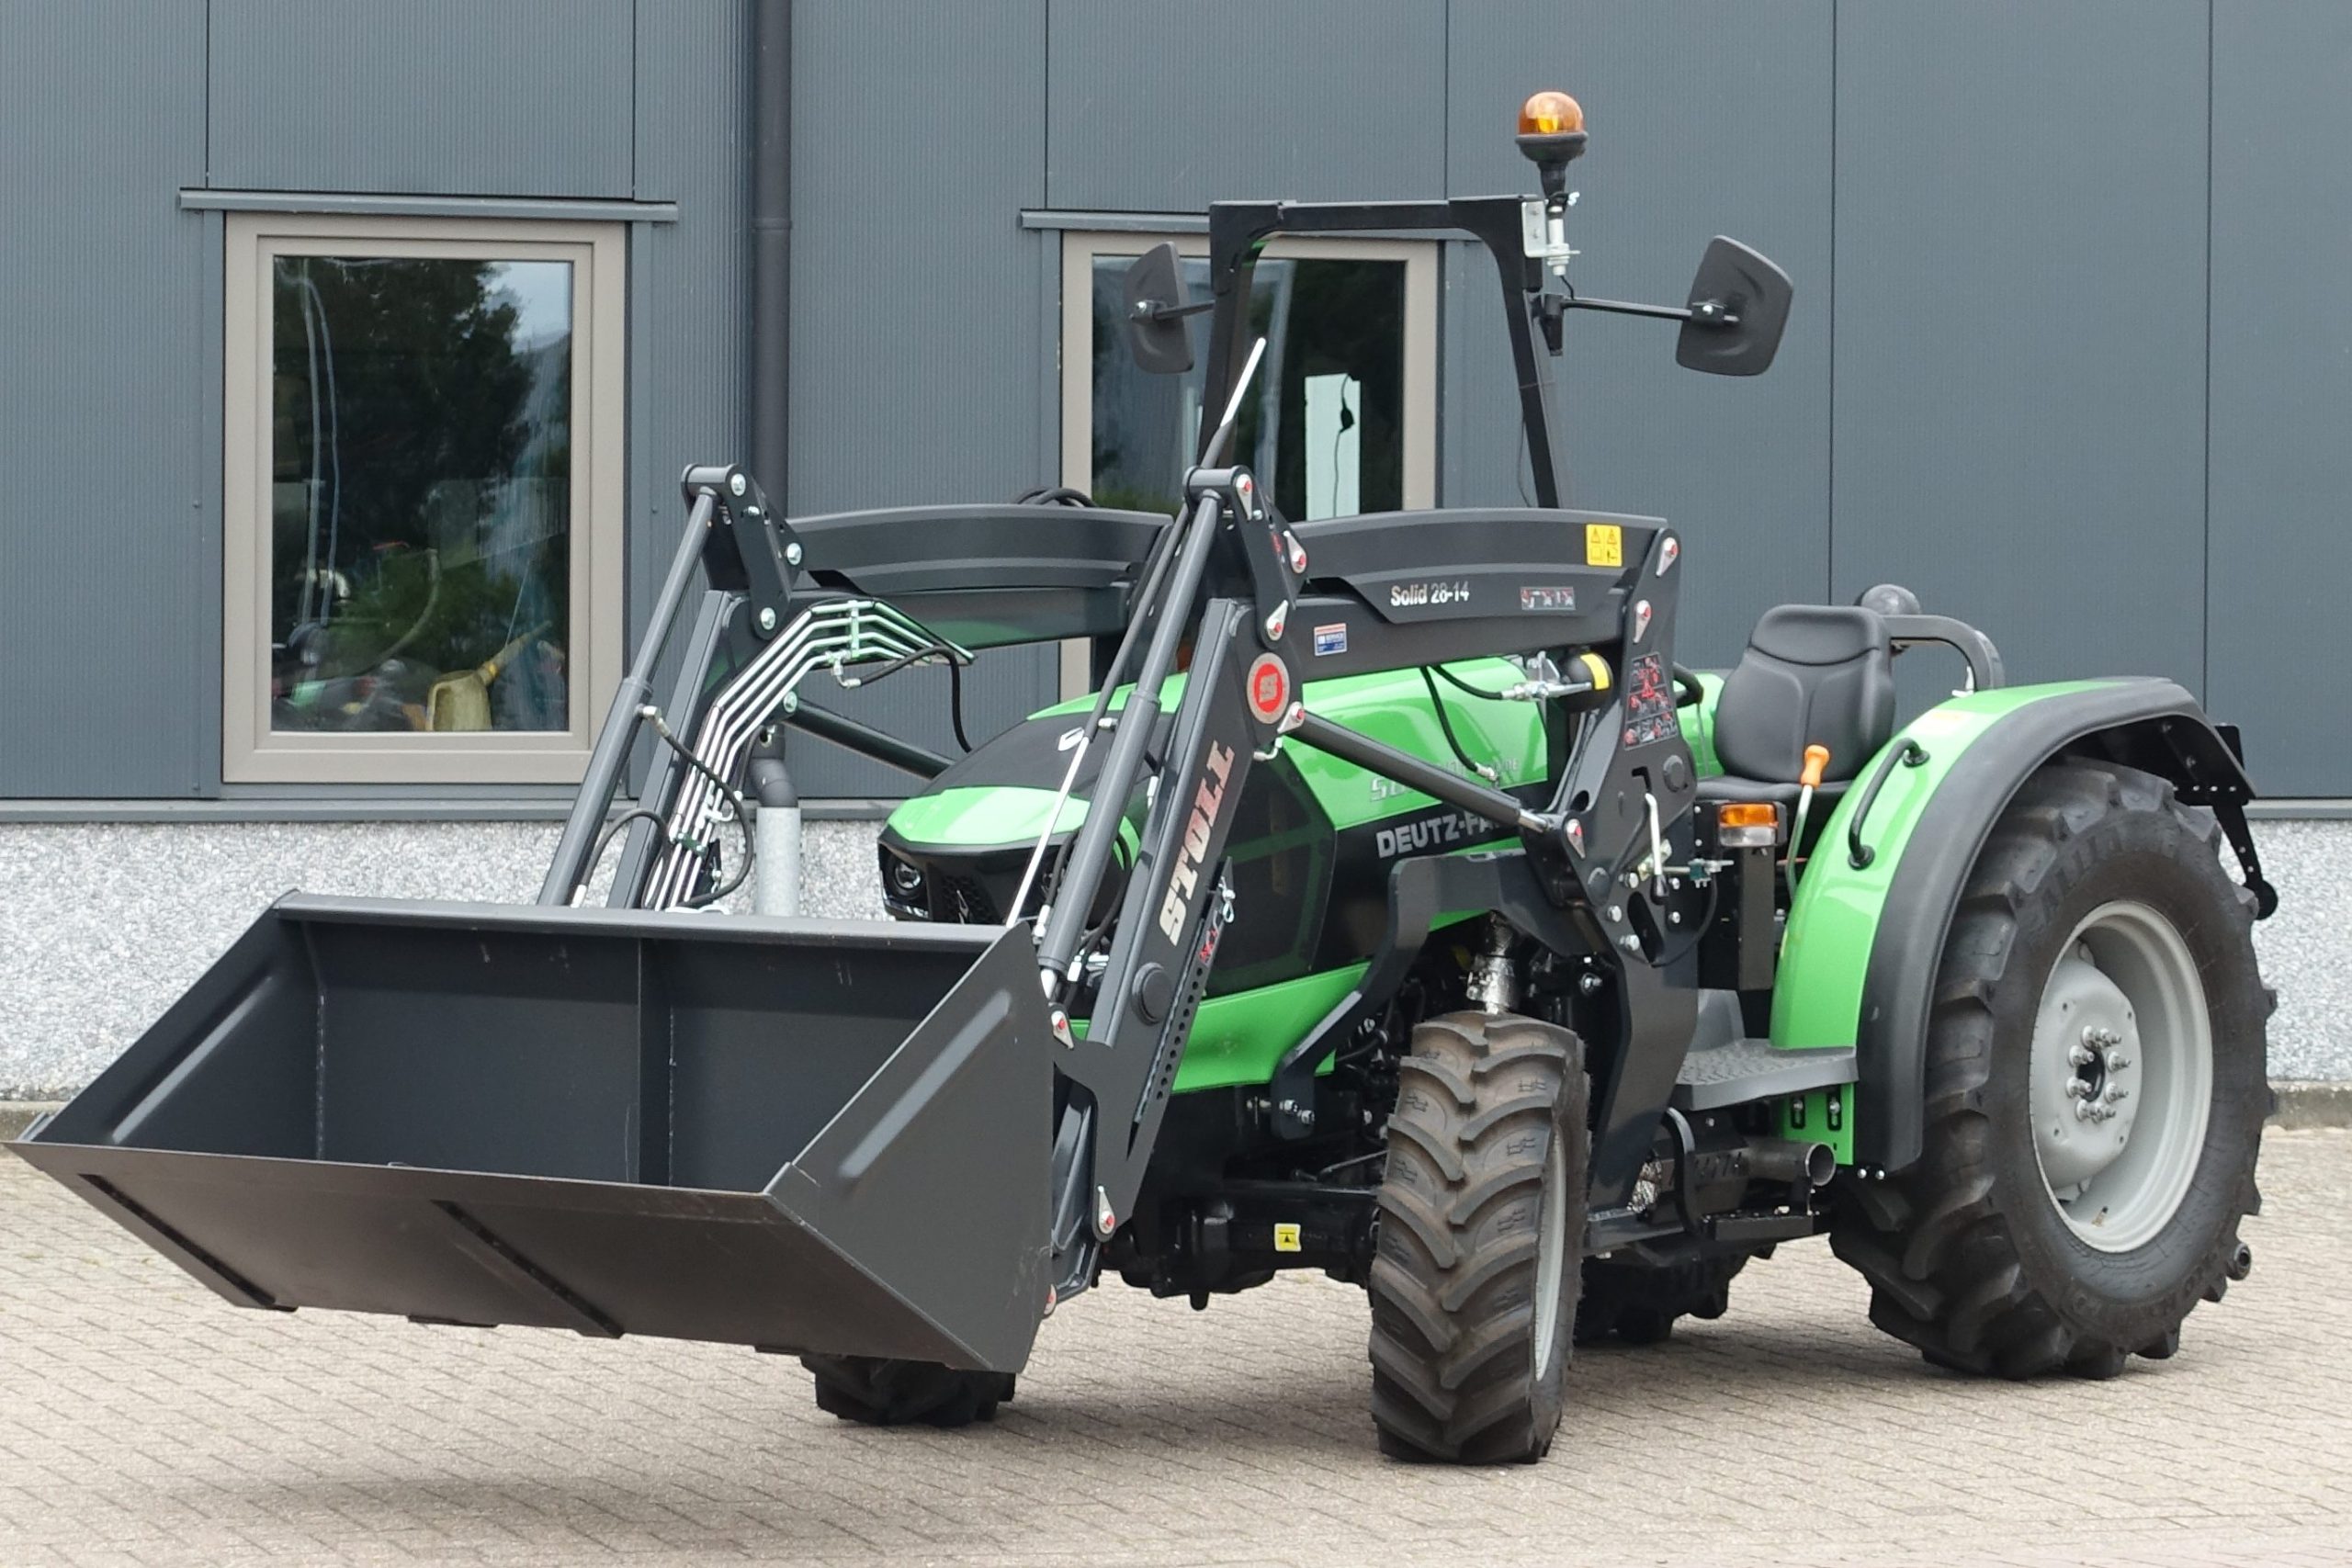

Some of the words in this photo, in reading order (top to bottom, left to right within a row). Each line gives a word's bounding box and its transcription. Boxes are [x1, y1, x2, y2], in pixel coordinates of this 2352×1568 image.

[1390, 584, 1429, 607] Solid
[1430, 581, 1470, 604] 28-14
[1159, 740, 1235, 946] STOLL
[1375, 809, 1500, 859] DEUTZ-FA
